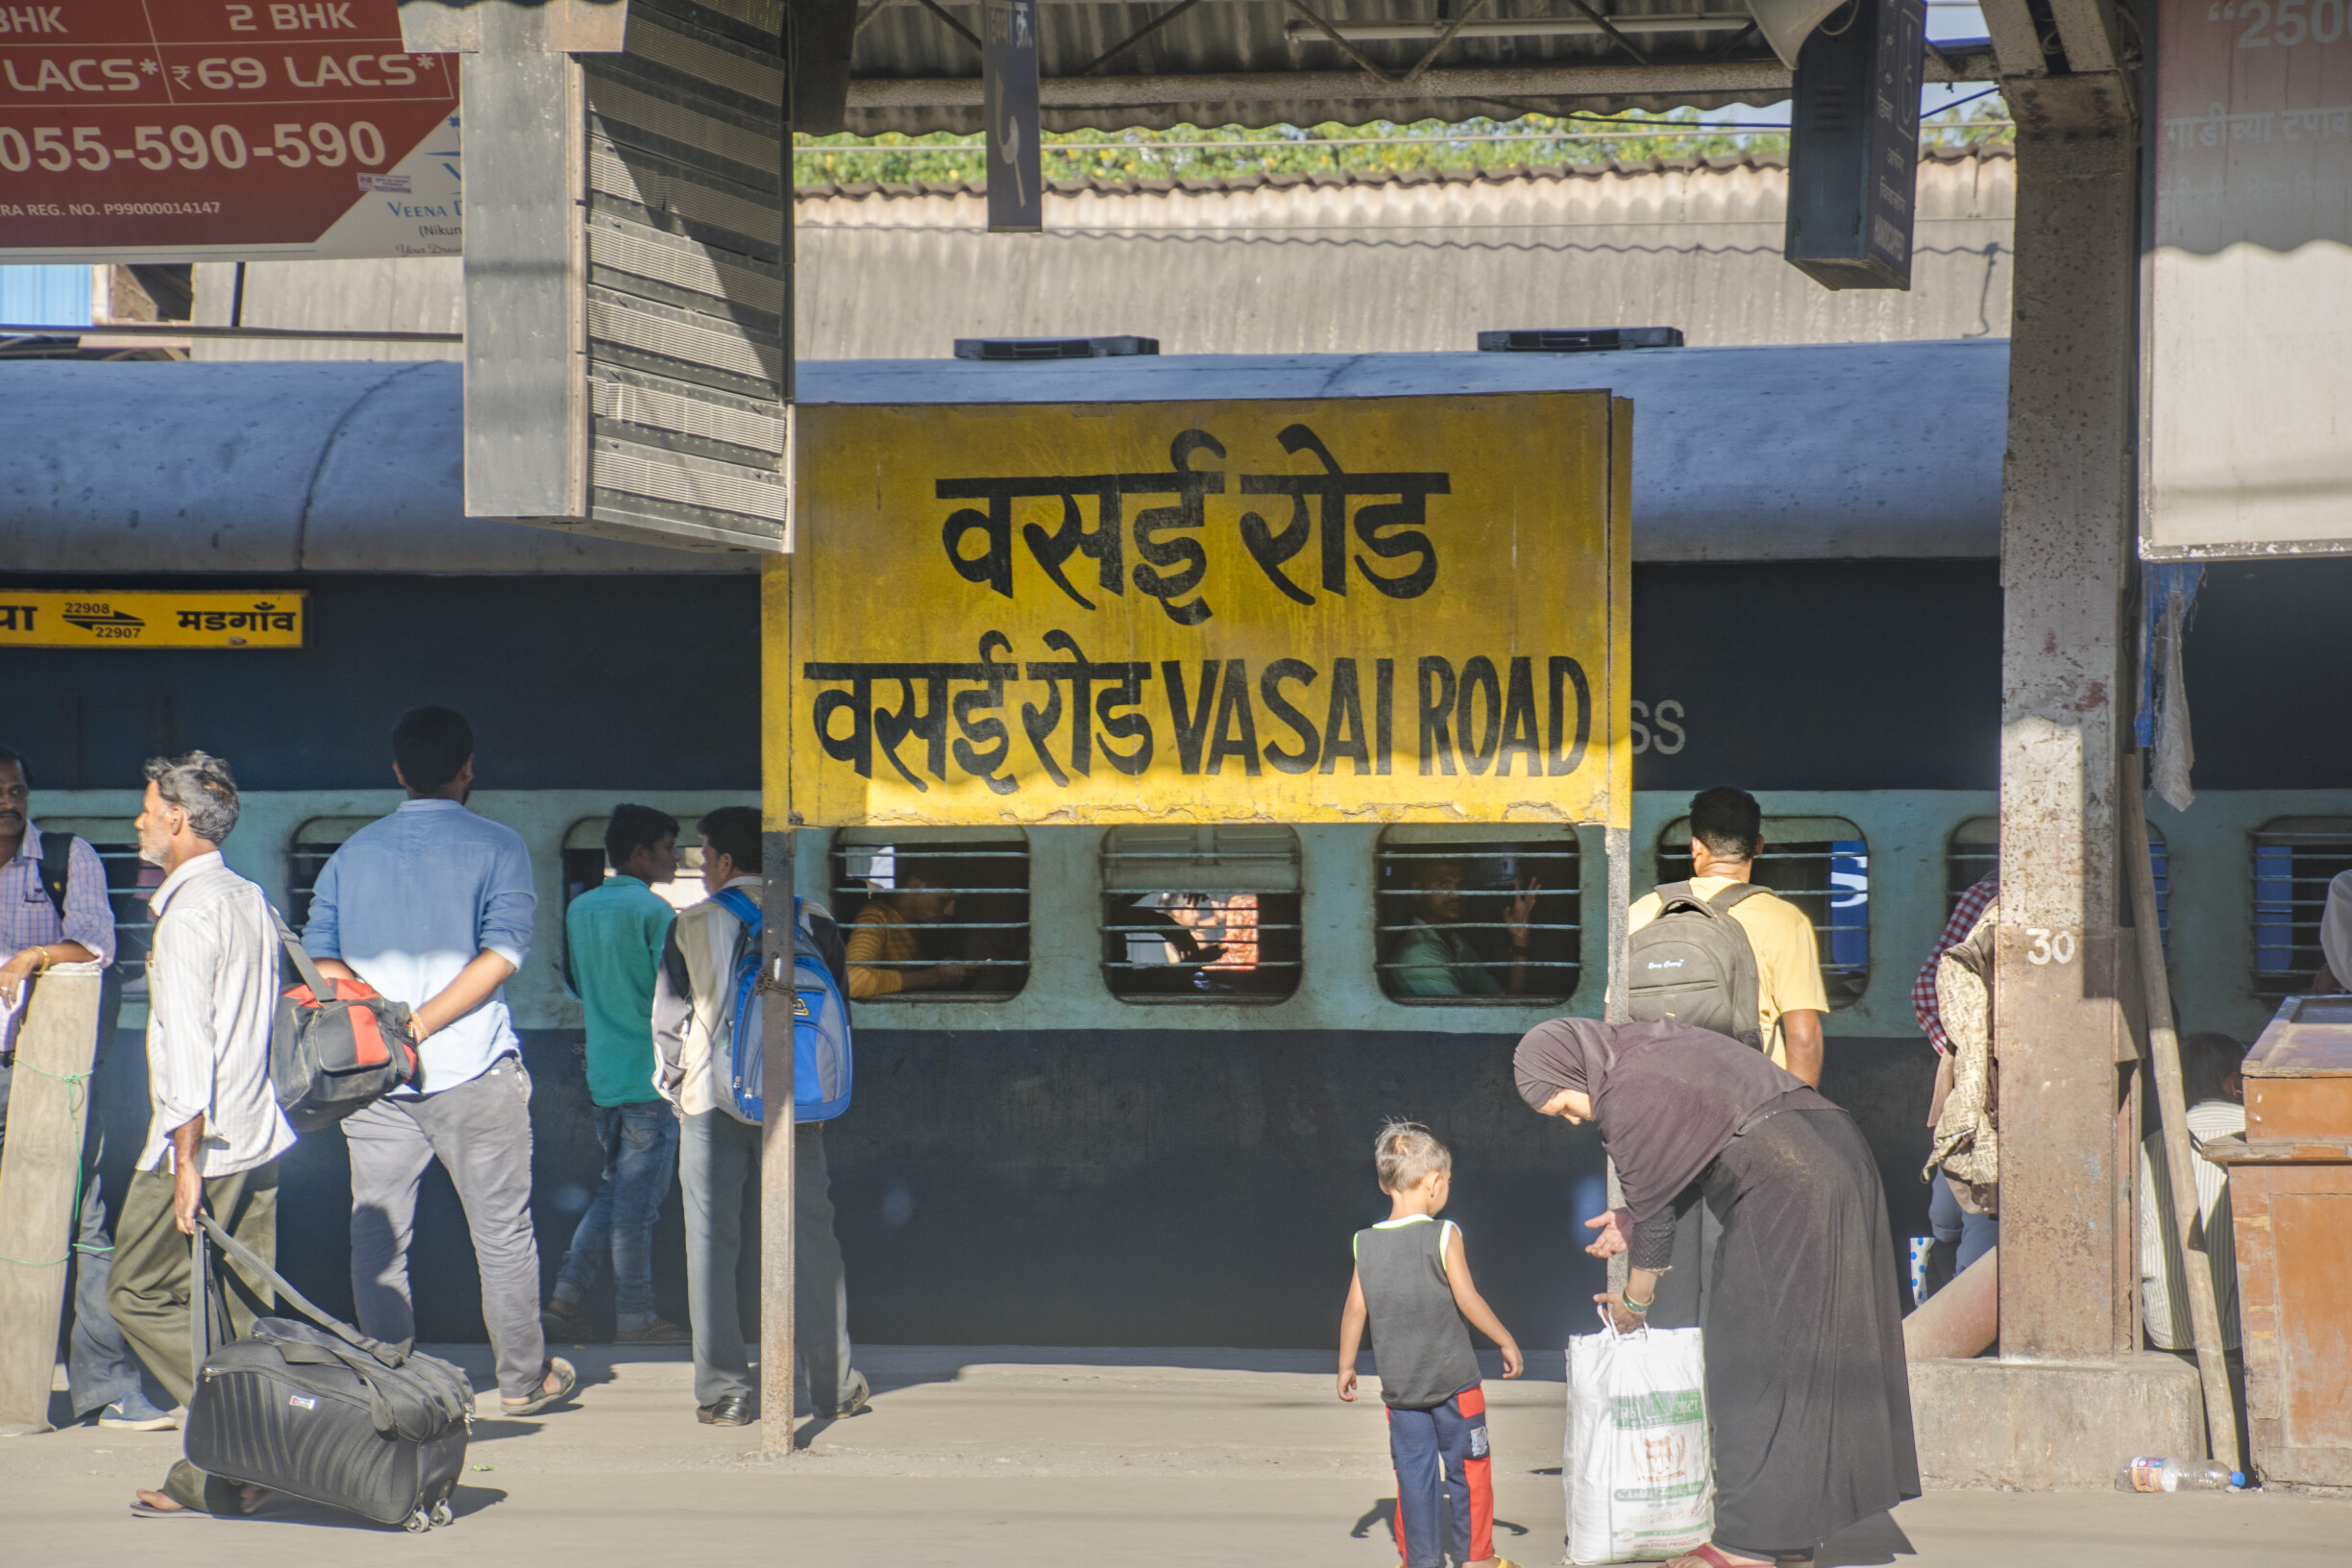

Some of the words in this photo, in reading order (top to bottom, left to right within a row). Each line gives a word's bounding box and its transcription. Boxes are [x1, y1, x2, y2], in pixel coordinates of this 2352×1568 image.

[227, 4, 258, 32] 2
[269, 3, 356, 31] BHK
[2209, 0, 2352, 48] “250
[171, 58, 268, 91] ₹69
[27, 204, 66, 216] REG.
[68, 203, 100, 216] NO.
[104, 202, 220, 215] P99000014147
[386, 200, 448, 217] VEENA
[935, 428, 1225, 625] वसई
[1238, 423, 1451, 606] रोड
[64, 601, 110, 614] 22908
[96, 626, 141, 638] 22907
[803, 629, 1017, 795] वसई
[1021, 629, 1153, 788] रोड
[1163, 657, 1394, 777] VASAI
[1417, 654, 1591, 777] ROAD
[2025, 927, 2075, 965] 30
